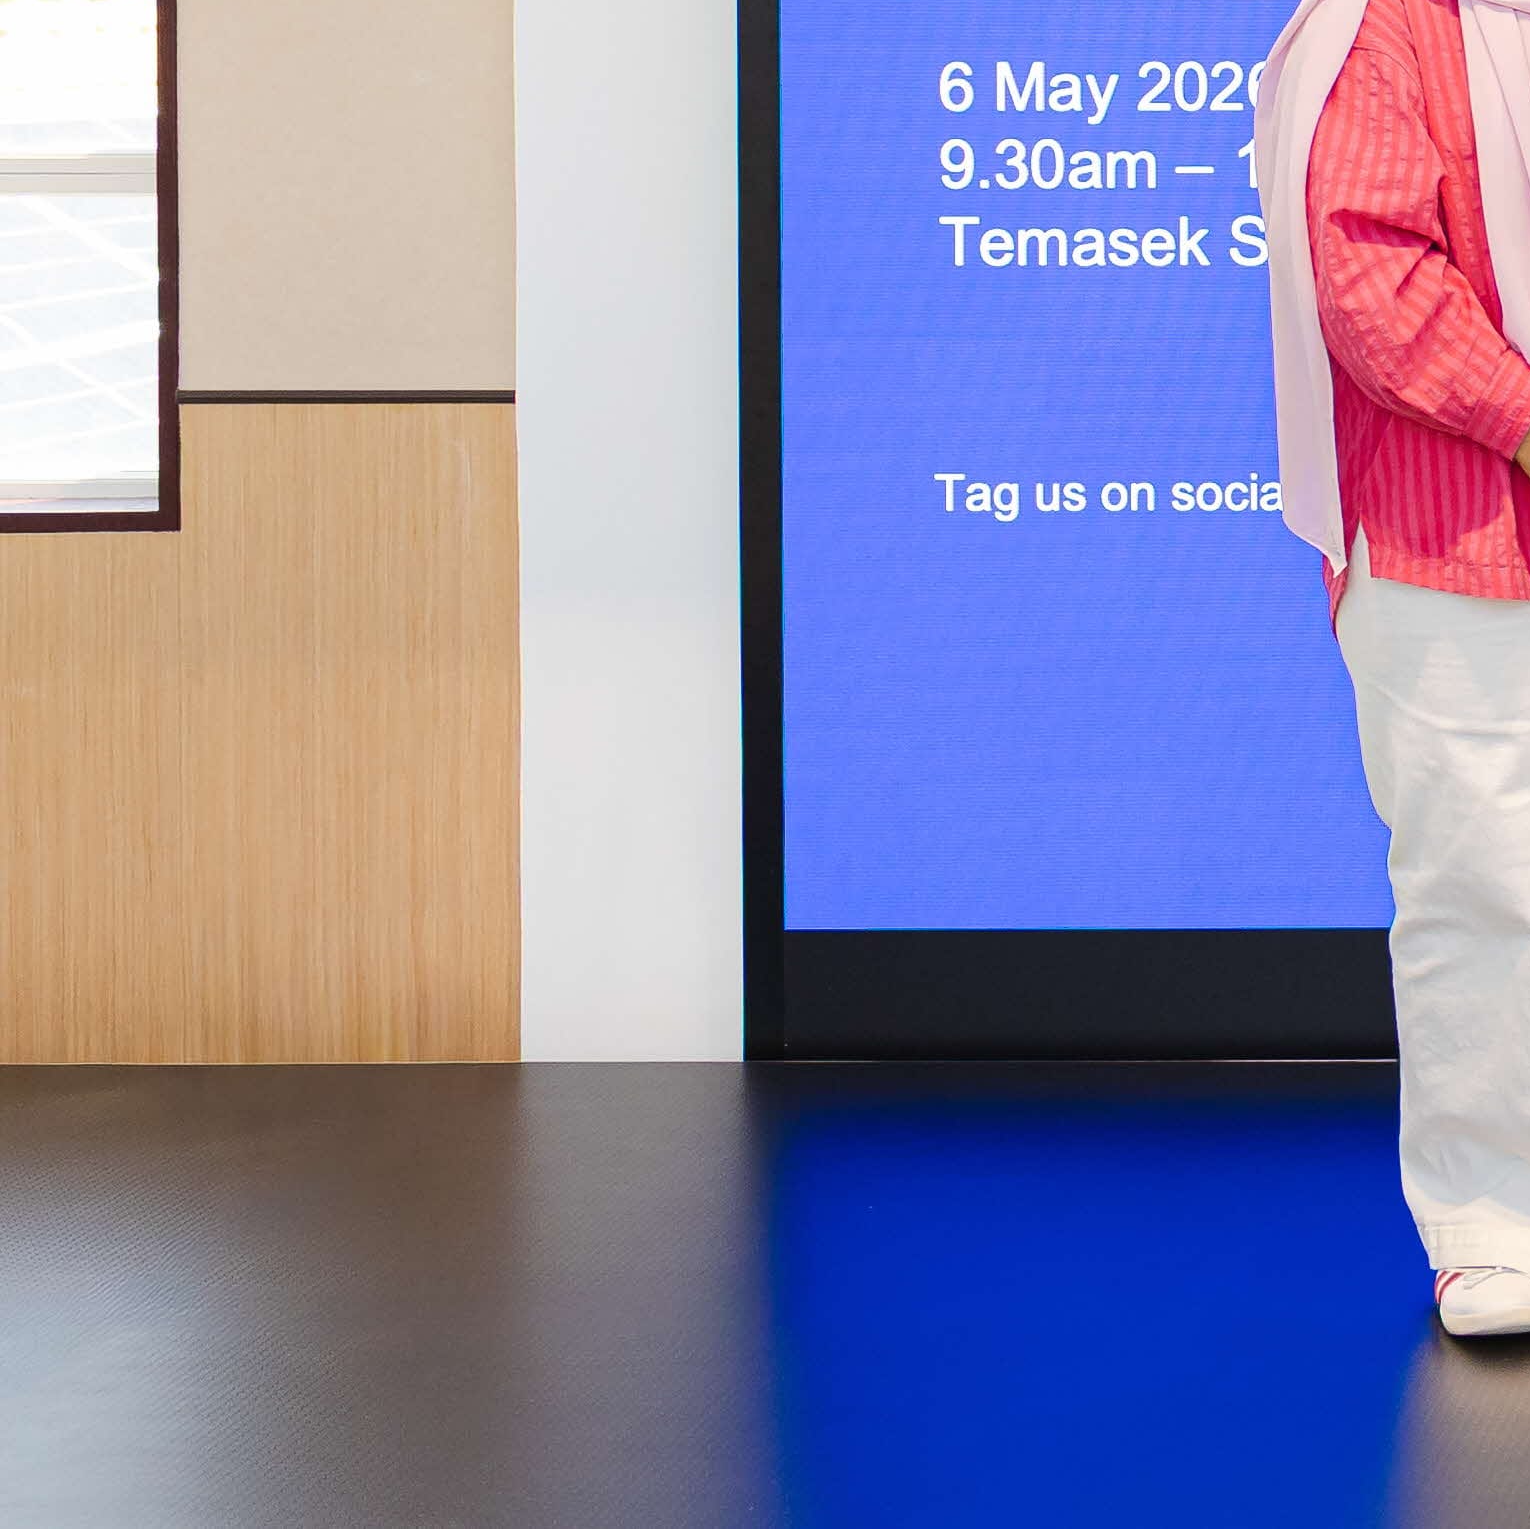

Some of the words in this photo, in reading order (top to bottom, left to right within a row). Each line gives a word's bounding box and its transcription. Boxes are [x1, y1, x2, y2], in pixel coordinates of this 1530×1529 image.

[939, 60, 974, 112] 6
[995, 61, 1119, 125] May
[940, 138, 1157, 189] 9.30am
[938, 215, 1211, 267] Temasek
[934, 473, 1019, 521] Tag
[1036, 480, 1087, 512] us
[1101, 480, 1155, 512] on
